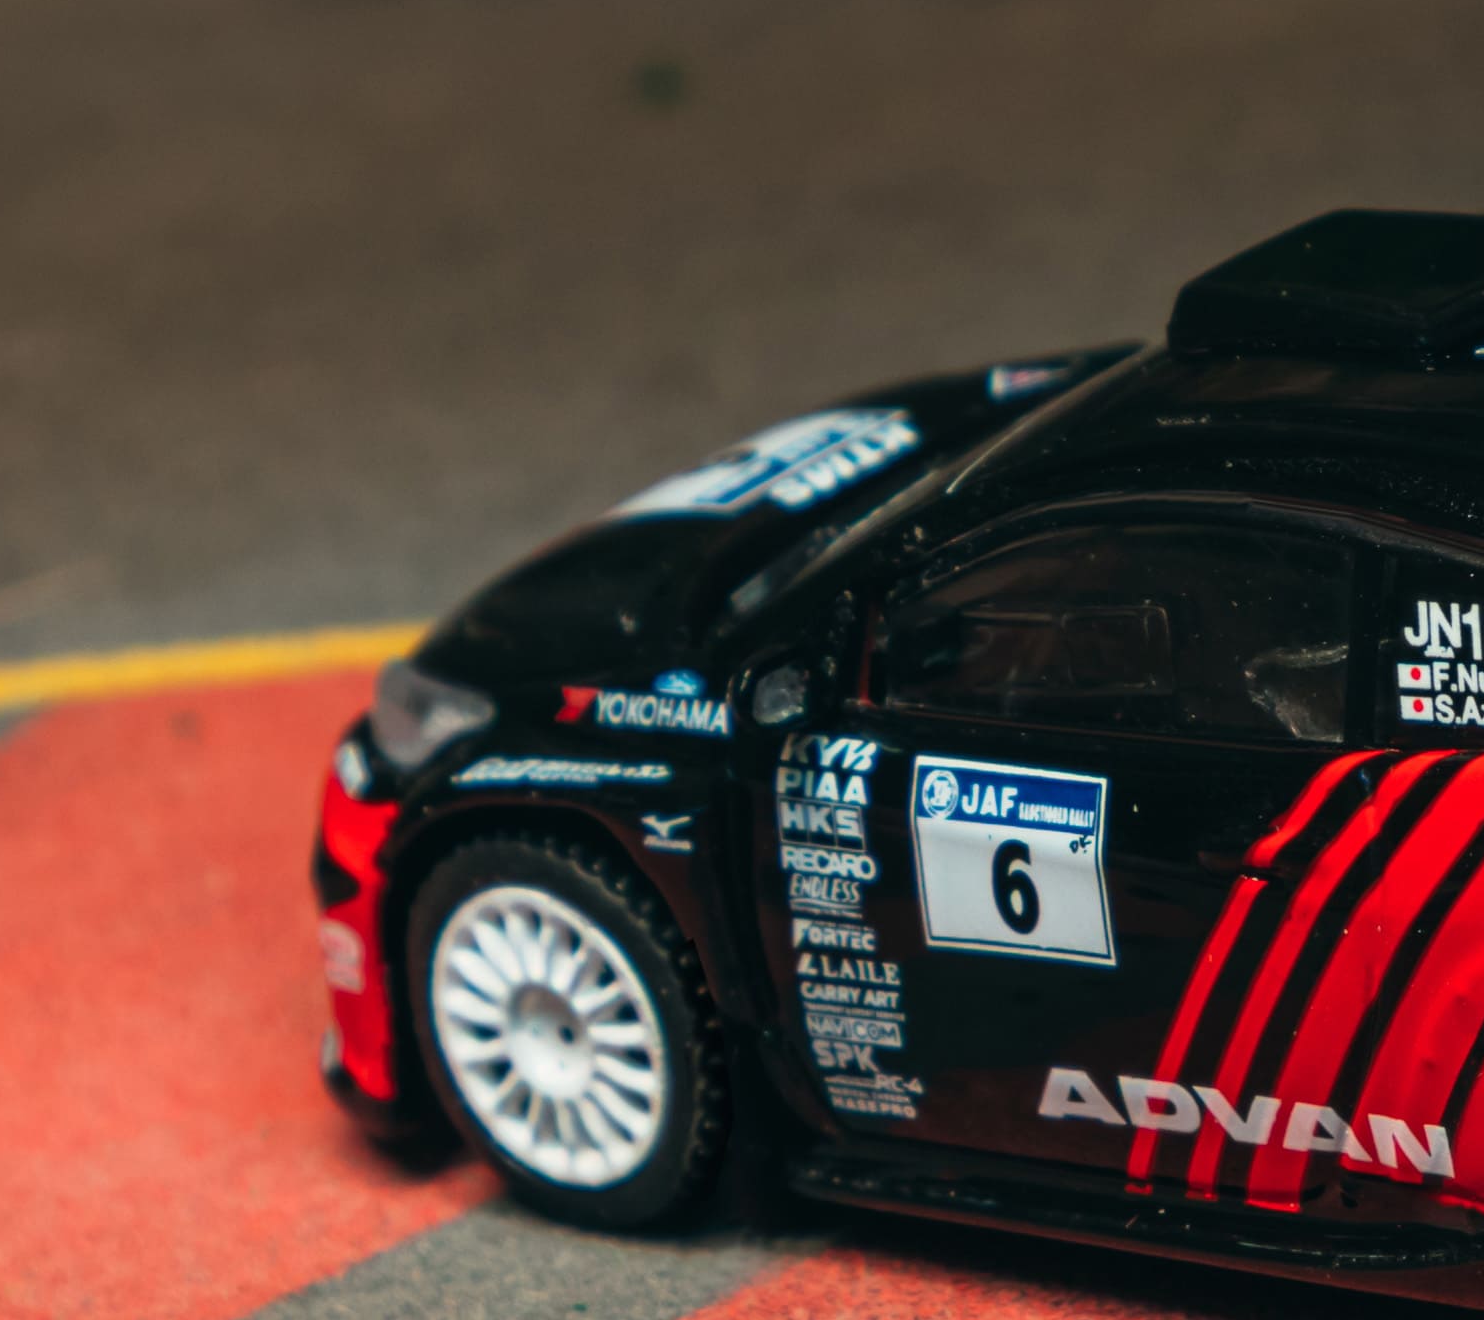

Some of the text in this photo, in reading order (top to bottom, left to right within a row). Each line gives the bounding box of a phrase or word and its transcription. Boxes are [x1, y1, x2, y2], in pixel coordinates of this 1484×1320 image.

[1403, 600, 1482, 660] JN1
[596, 691, 729, 734] YOKOHAMA
[780, 733, 877, 771] KYB
[777, 766, 868, 805] PIAA
[961, 783, 1018, 817] JAF
[780, 801, 863, 838] HKS
[781, 846, 877, 881] RECARO
[790, 872, 861, 903] ENDLESS
[991, 838, 1041, 935] 6
[800, 981, 900, 1009] CARRY ART
[812, 1039, 881, 1074] SPK
[1037, 1067, 1455, 1179] ADVAN
